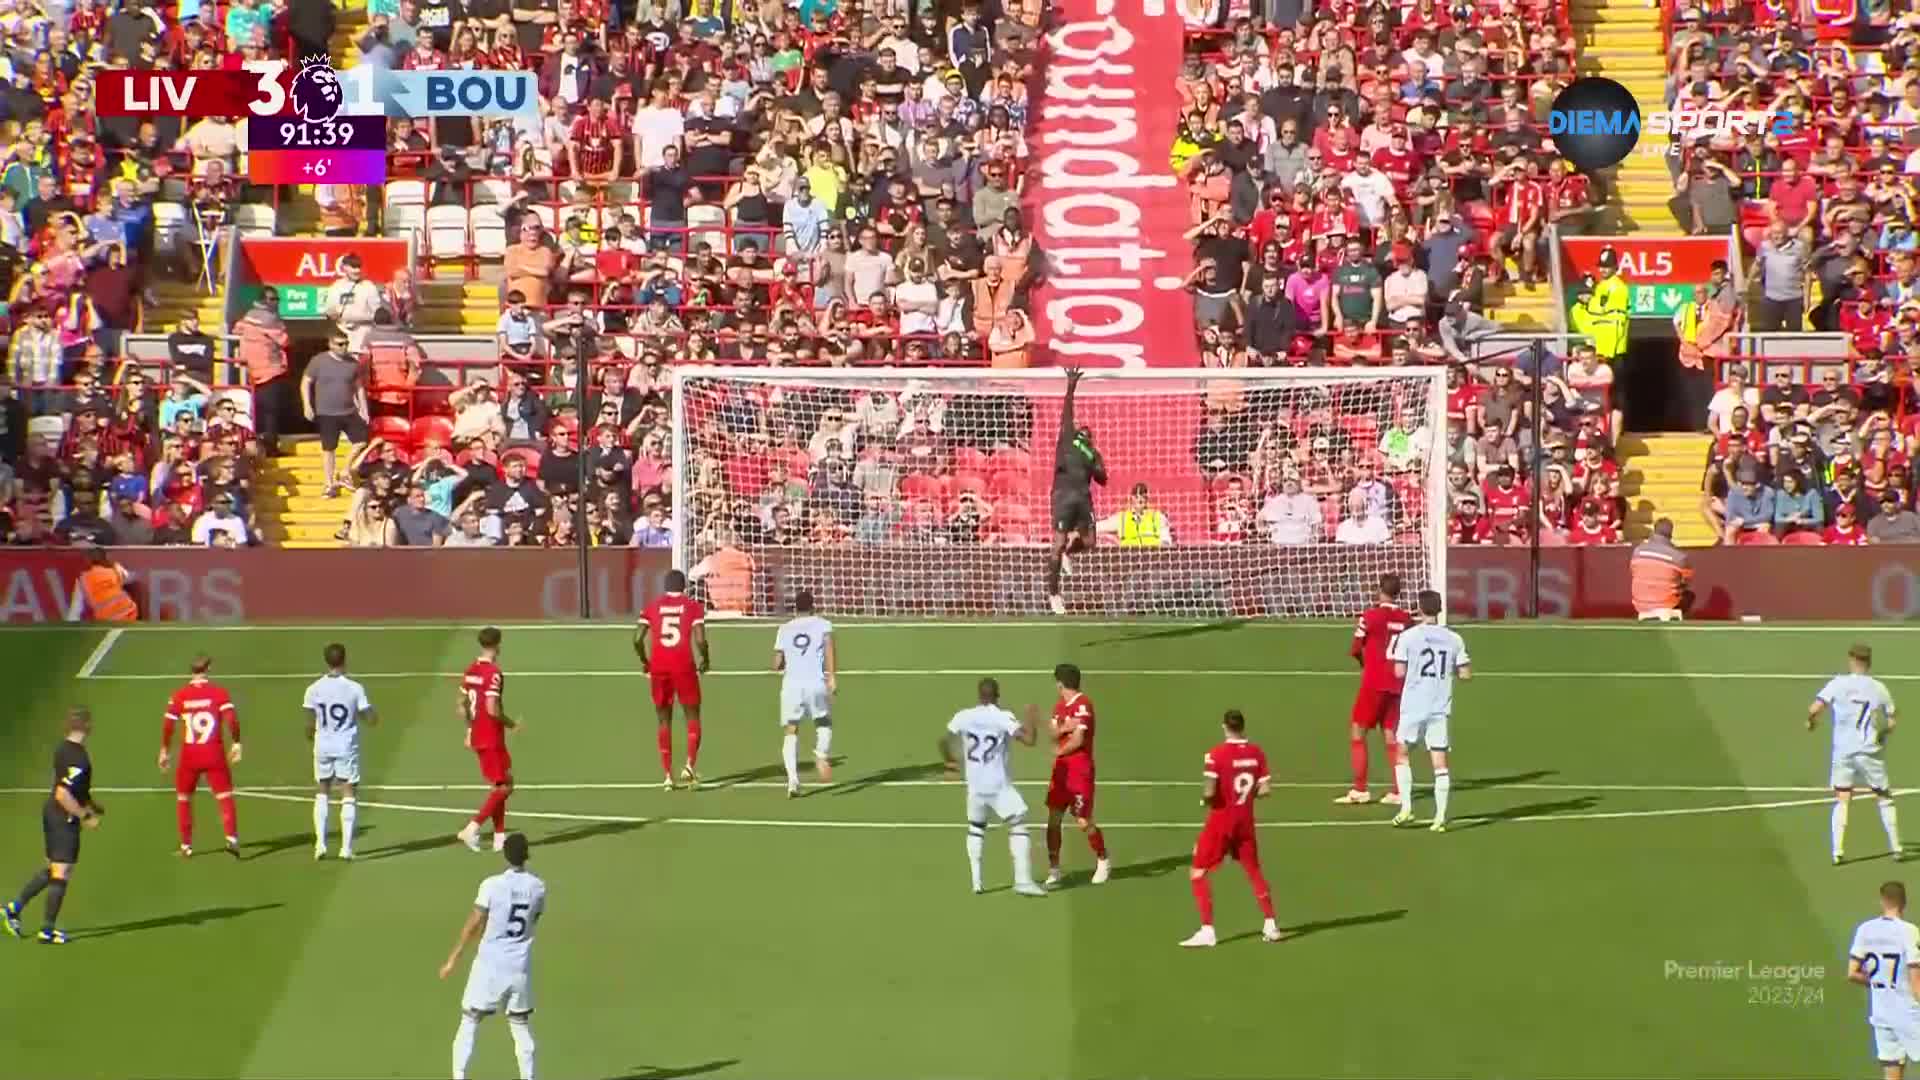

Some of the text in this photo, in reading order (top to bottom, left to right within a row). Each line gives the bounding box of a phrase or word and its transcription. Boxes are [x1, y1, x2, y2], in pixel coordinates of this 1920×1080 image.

[1616, 252, 1673, 277] AL5
[659, 616, 682, 647] 5
[792, 633, 811, 656] 9
[1420, 647, 1448, 679] 21
[181, 711, 216, 744] 19
[318, 702, 349, 732] 19
[1851, 699, 1870, 729] 7
[966, 732, 1000, 763] 22
[1233, 771, 1255, 806] 9
[506, 903, 530, 937] 5
[1861, 951, 1902, 989] 27
